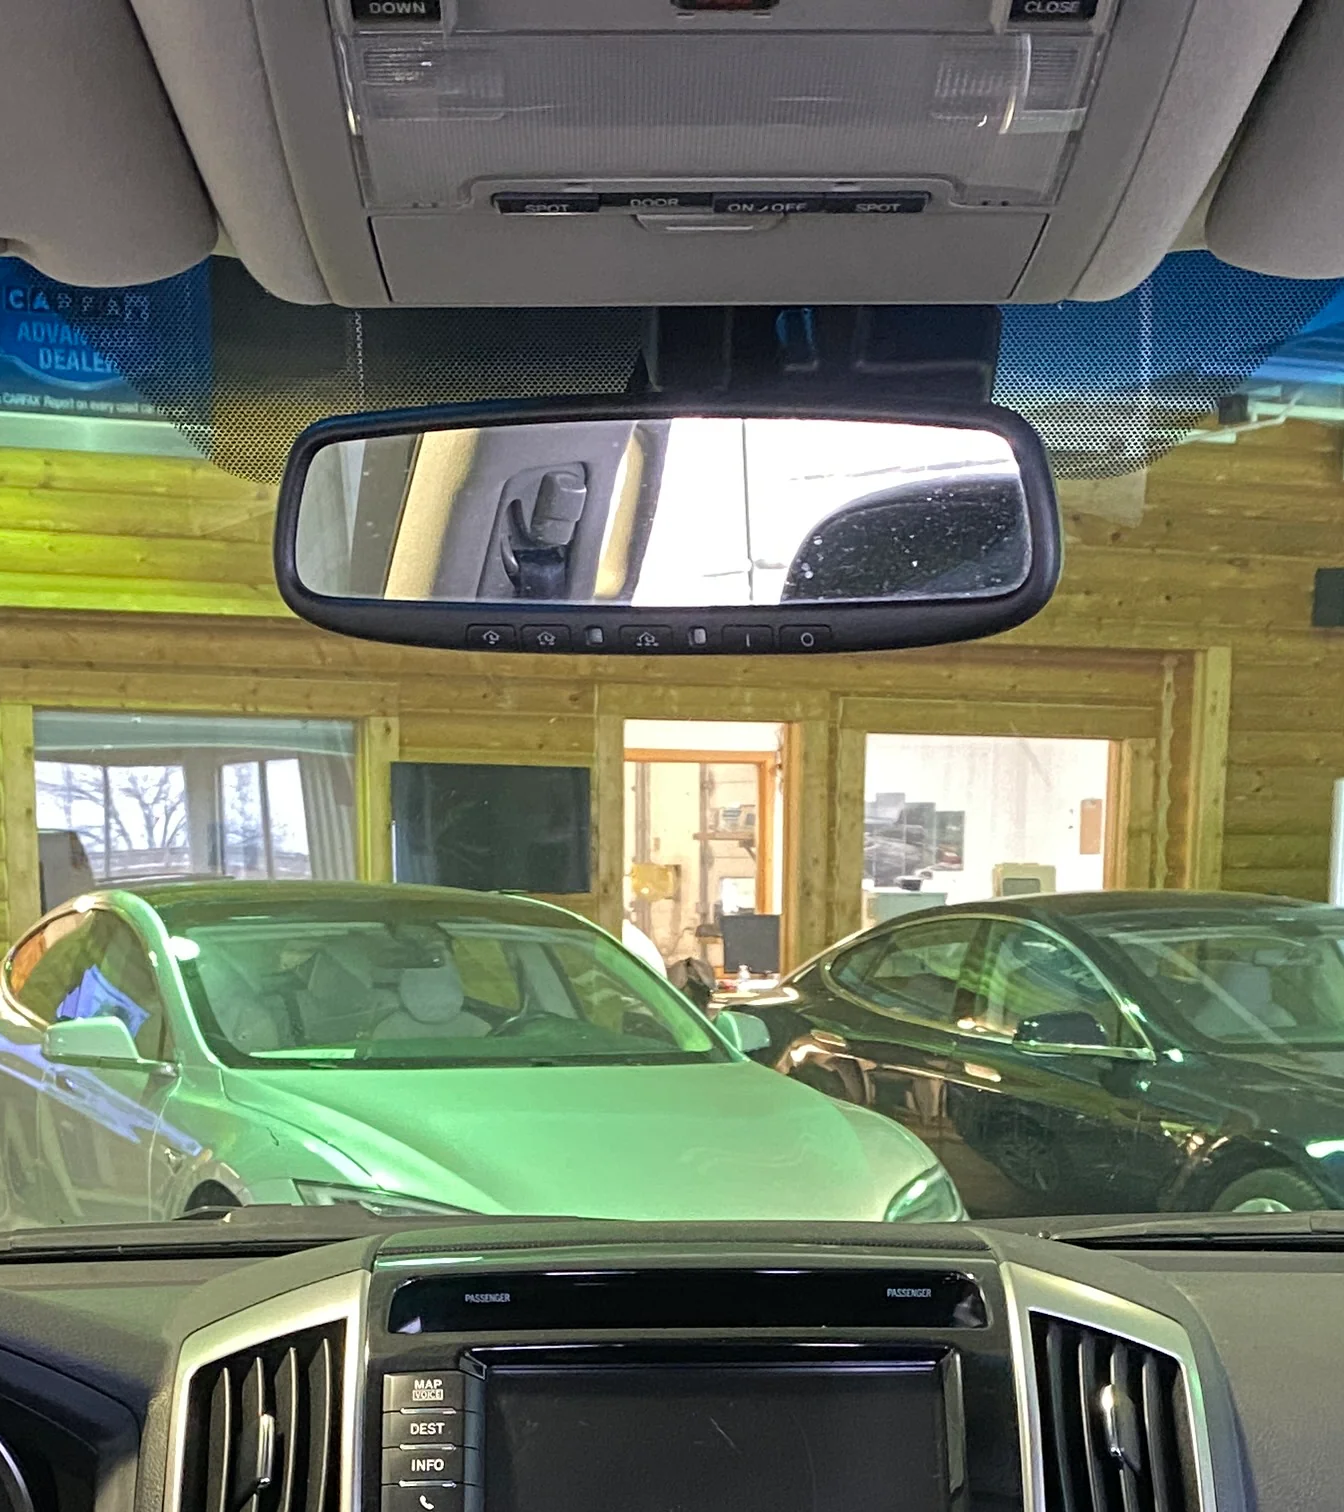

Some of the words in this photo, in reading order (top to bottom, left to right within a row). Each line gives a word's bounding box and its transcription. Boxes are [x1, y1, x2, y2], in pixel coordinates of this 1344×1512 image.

[369, 2, 427, 14] DOWN
[1024, 1, 1080, 14] CLOSE
[525, 203, 570, 213] SPOT
[857, 203, 901, 213] SPOT
[464, 1292, 511, 1303] PASSENGER
[886, 1287, 932, 1298] PASSENGER
[414, 1379, 443, 1390] MAP
[410, 1422, 445, 1435] DEST
[411, 1459, 445, 1472] INFO
